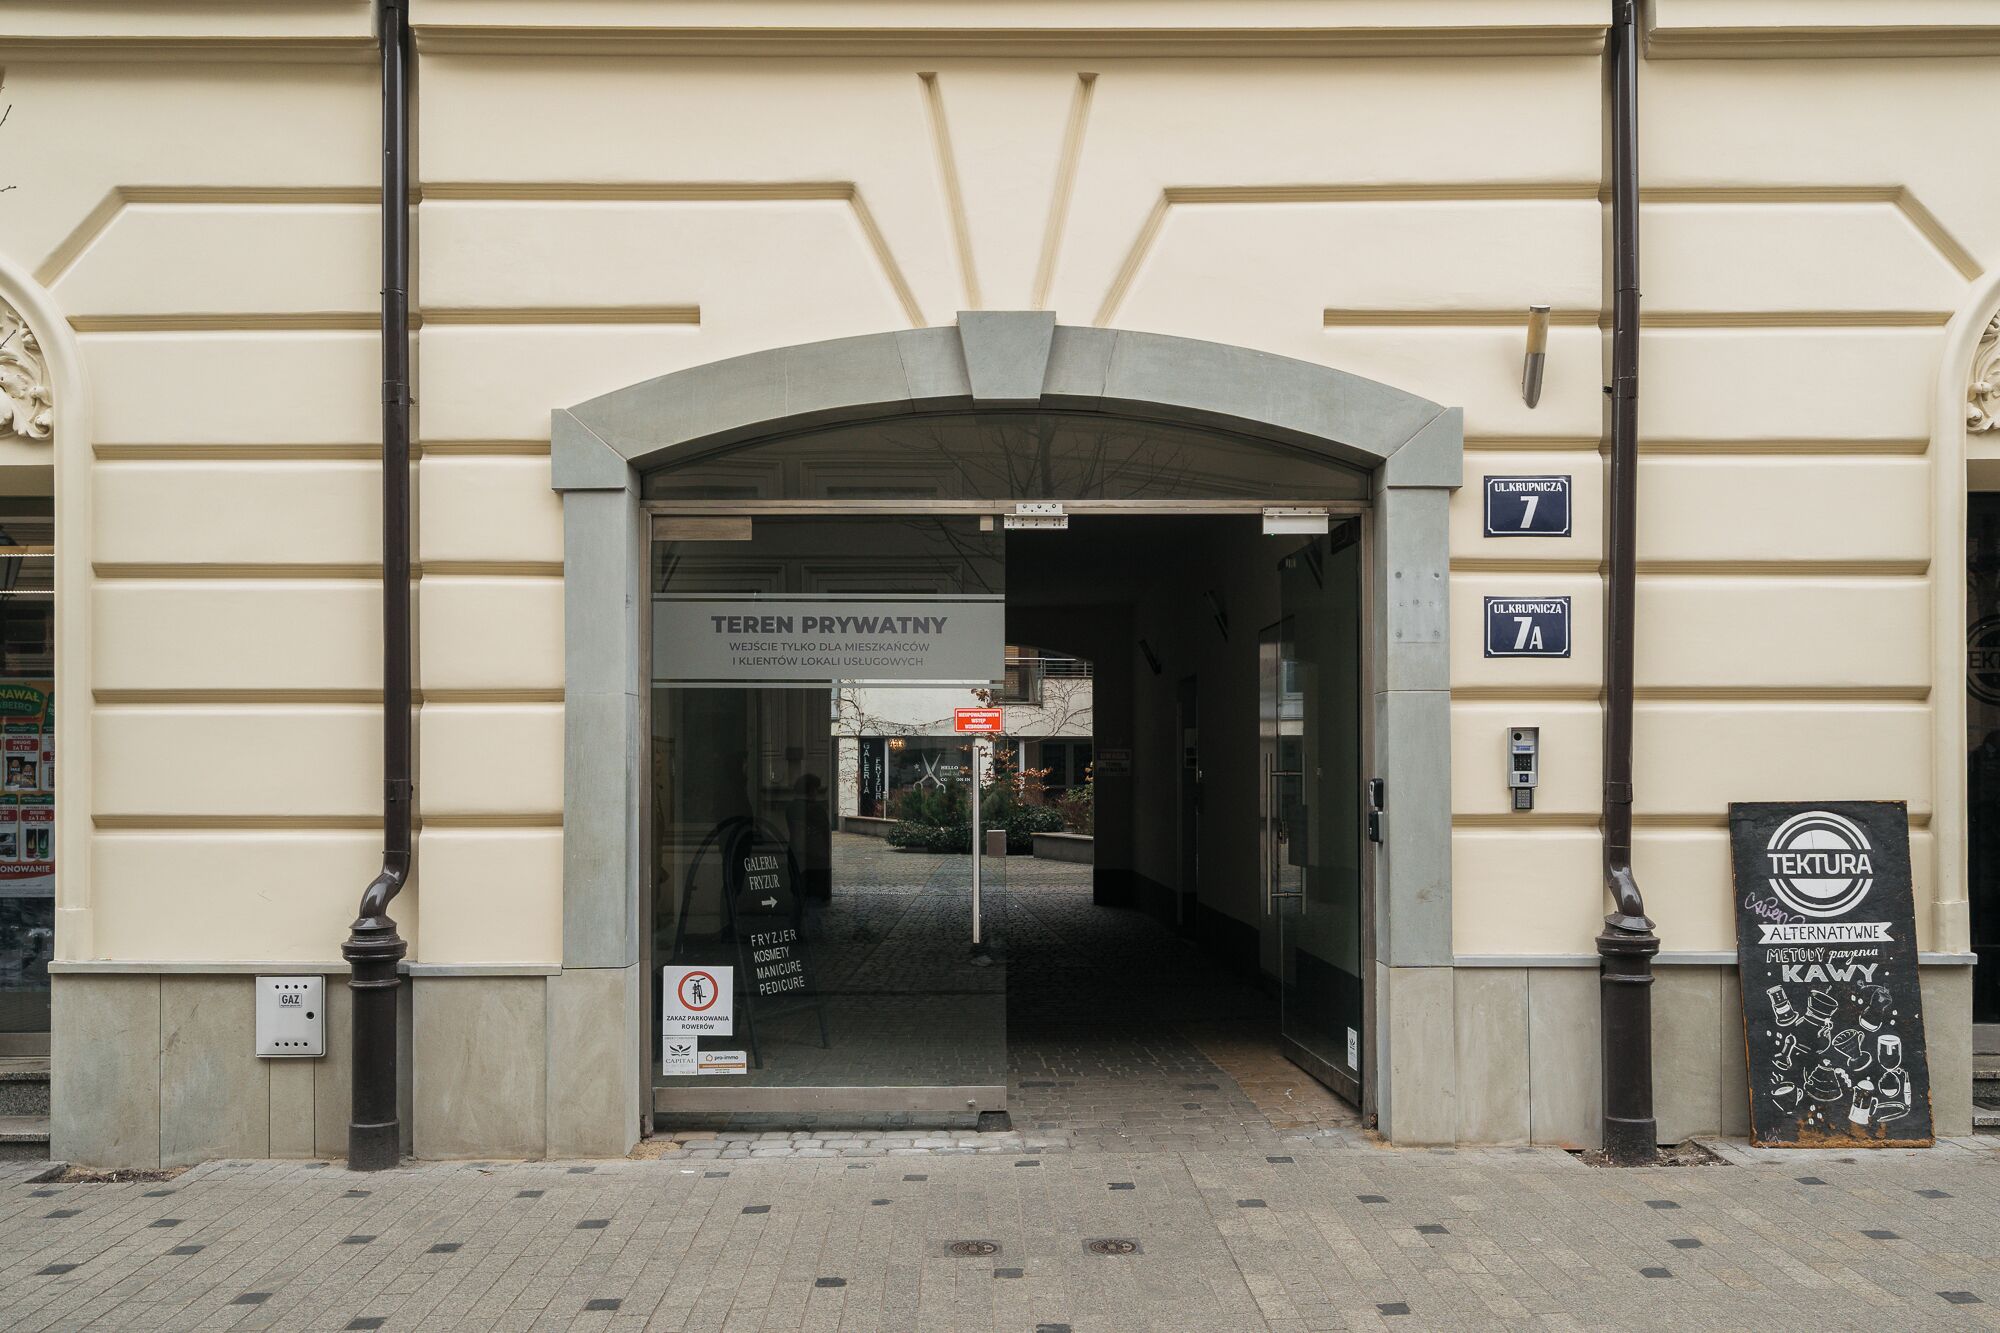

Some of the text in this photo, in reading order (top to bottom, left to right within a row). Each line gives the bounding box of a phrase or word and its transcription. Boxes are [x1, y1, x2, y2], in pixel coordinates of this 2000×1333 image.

[1520, 495, 1539, 528] 7
[711, 615, 948, 634] TEREN PRYWATNY
[1513, 616, 1543, 650] 7A
[729, 639, 930, 652] WEJŚCIE TYLKO DLA MIESZKAŃCÓW
[738, 654, 798, 666] KLIENTÓW
[800, 656, 840, 666] LOKALI
[843, 656, 924, 667] USŁUGOWYCH
[743, 855, 779, 872] GALERIA
[1767, 853, 1873, 875] TEKTURA
[748, 874, 780, 891] FRYZUR
[750, 929, 797, 947] FRYZJER
[1769, 925, 1880, 941] ALTERNATYWNE
[753, 946, 790, 964] KOSMETY
[1766, 947, 1879, 966] METODY parzenia
[756, 960, 802, 980] MANICURE
[1782, 963, 1879, 983] KAWY
[759, 975, 806, 996] PEDICURE
[281, 994, 300, 1004] GAZ
[681, 1022, 715, 1030] ROWERÓW
